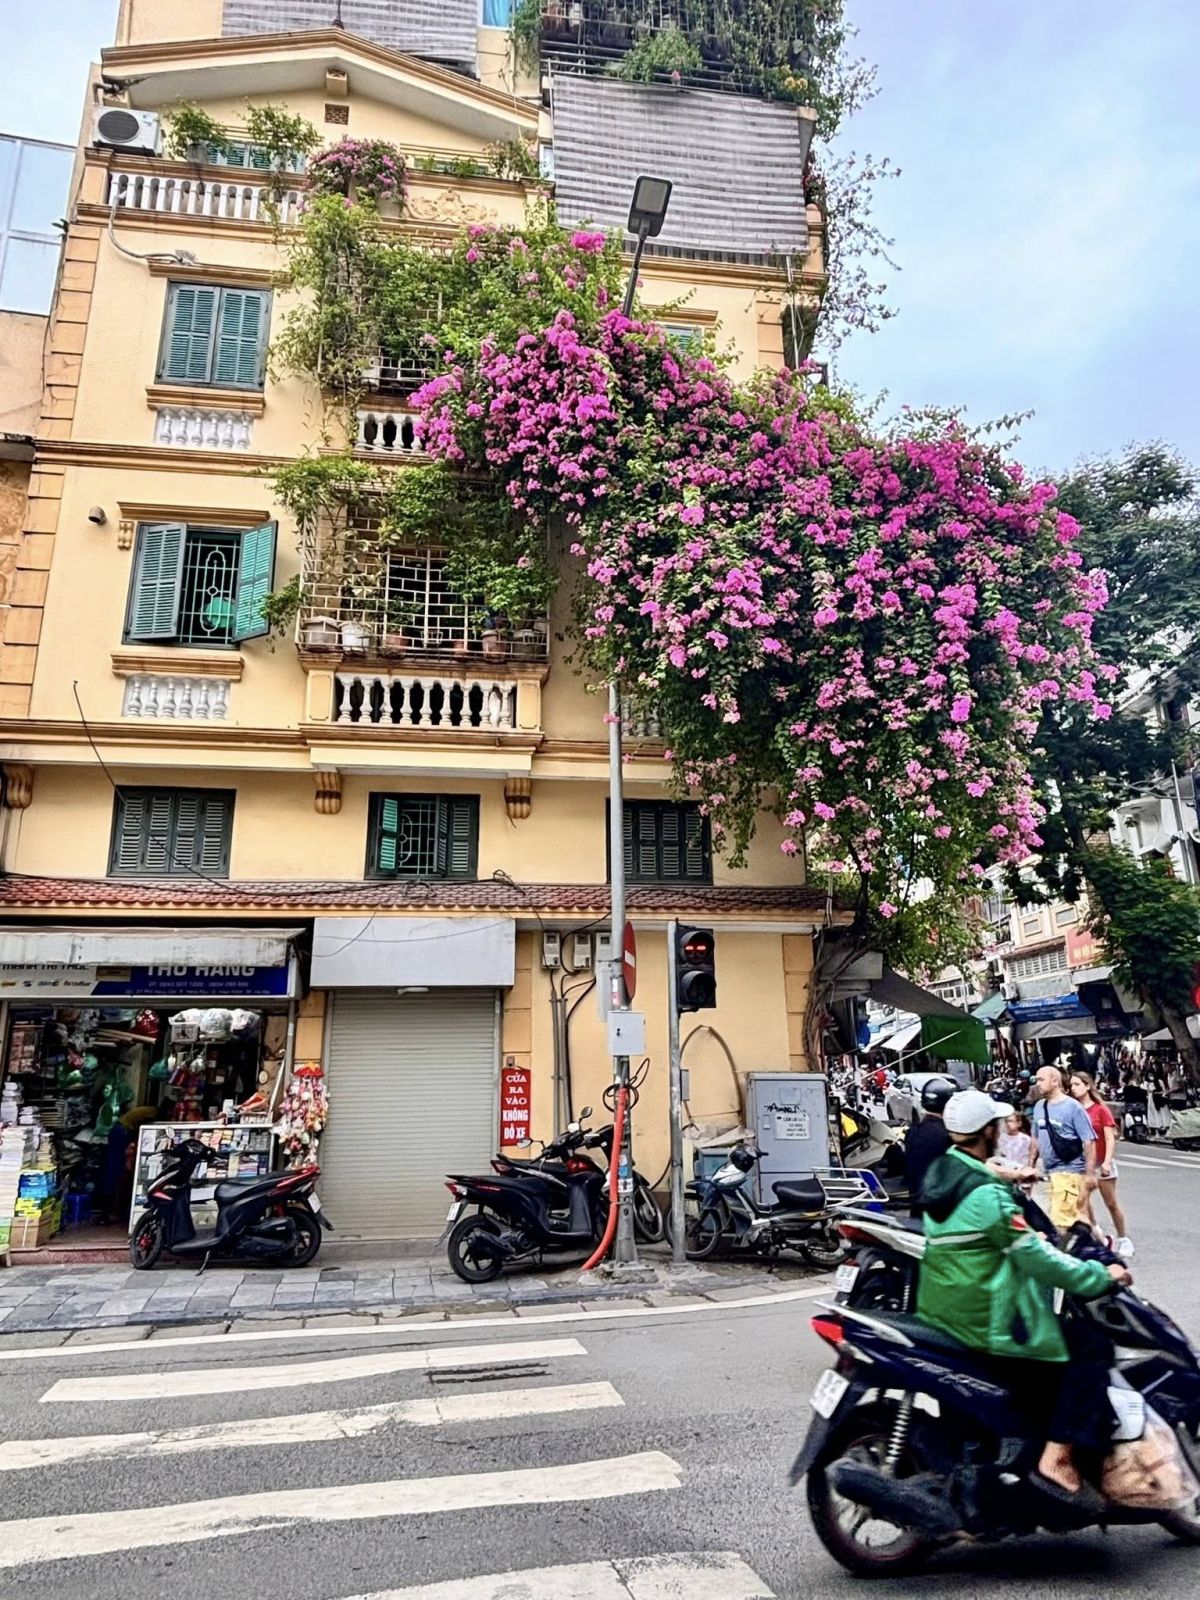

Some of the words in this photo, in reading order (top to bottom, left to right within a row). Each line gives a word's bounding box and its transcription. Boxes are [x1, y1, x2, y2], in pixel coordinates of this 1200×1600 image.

[506, 1072, 527, 1083] CỬA
[509, 1086, 524, 1094] RA
[505, 1095, 527, 1105] VÀO
[502, 1107, 529, 1121] KHÔNG
[515, 1127, 526, 1139] XE
